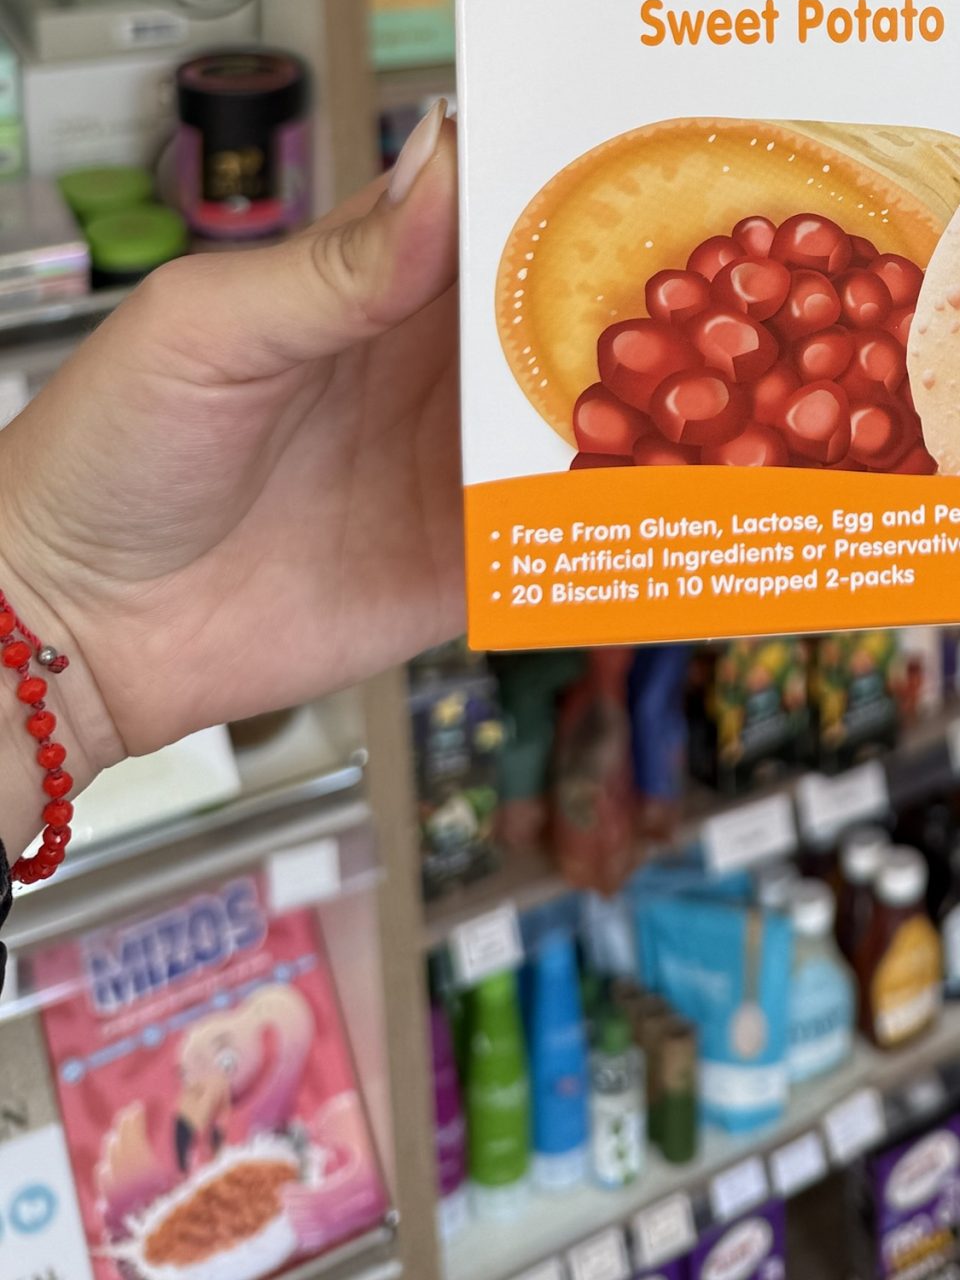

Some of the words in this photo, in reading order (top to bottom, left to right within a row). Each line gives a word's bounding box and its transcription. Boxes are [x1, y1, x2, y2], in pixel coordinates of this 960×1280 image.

[512, 525, 563, 546] Free
[572, 521, 631, 543] From
[639, 517, 723, 540] Gluten,
[732, 512, 823, 536] Lactose,
[832, 509, 873, 533] Egg
[882, 506, 926, 527] and
[513, 554, 546, 575] No
[554, 549, 654, 572] Artificial
[662, 542, 794, 570] Ingredients
[803, 541, 827, 559] or
[512, 584, 543, 605] 20
[551, 580, 639, 603] Biscuits
[648, 577, 669, 597] in
[676, 576, 703, 596] 10
[711, 570, 817, 598] Wrapped
[825, 565, 915, 590] 2-packs
